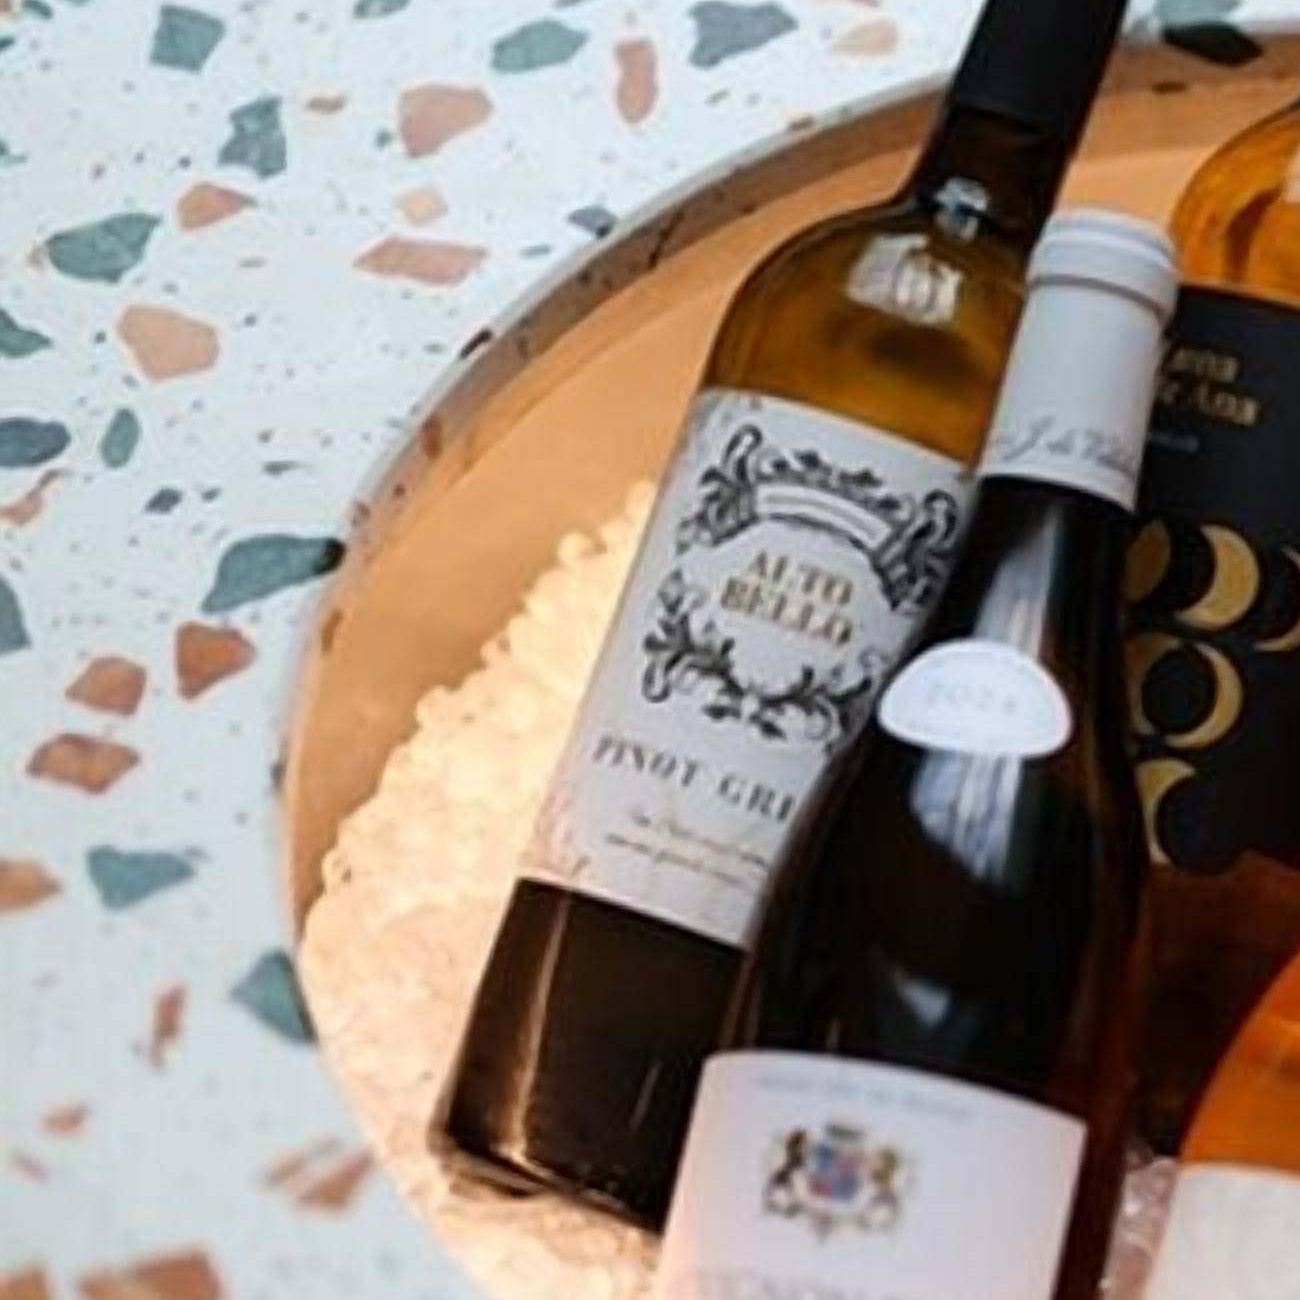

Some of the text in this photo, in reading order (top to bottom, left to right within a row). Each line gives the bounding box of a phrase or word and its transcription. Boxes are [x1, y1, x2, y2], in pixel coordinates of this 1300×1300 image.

[745, 551, 853, 606] ALTO
[720, 577, 852, 646] BELLO
[592, 735, 700, 788] PINOT
